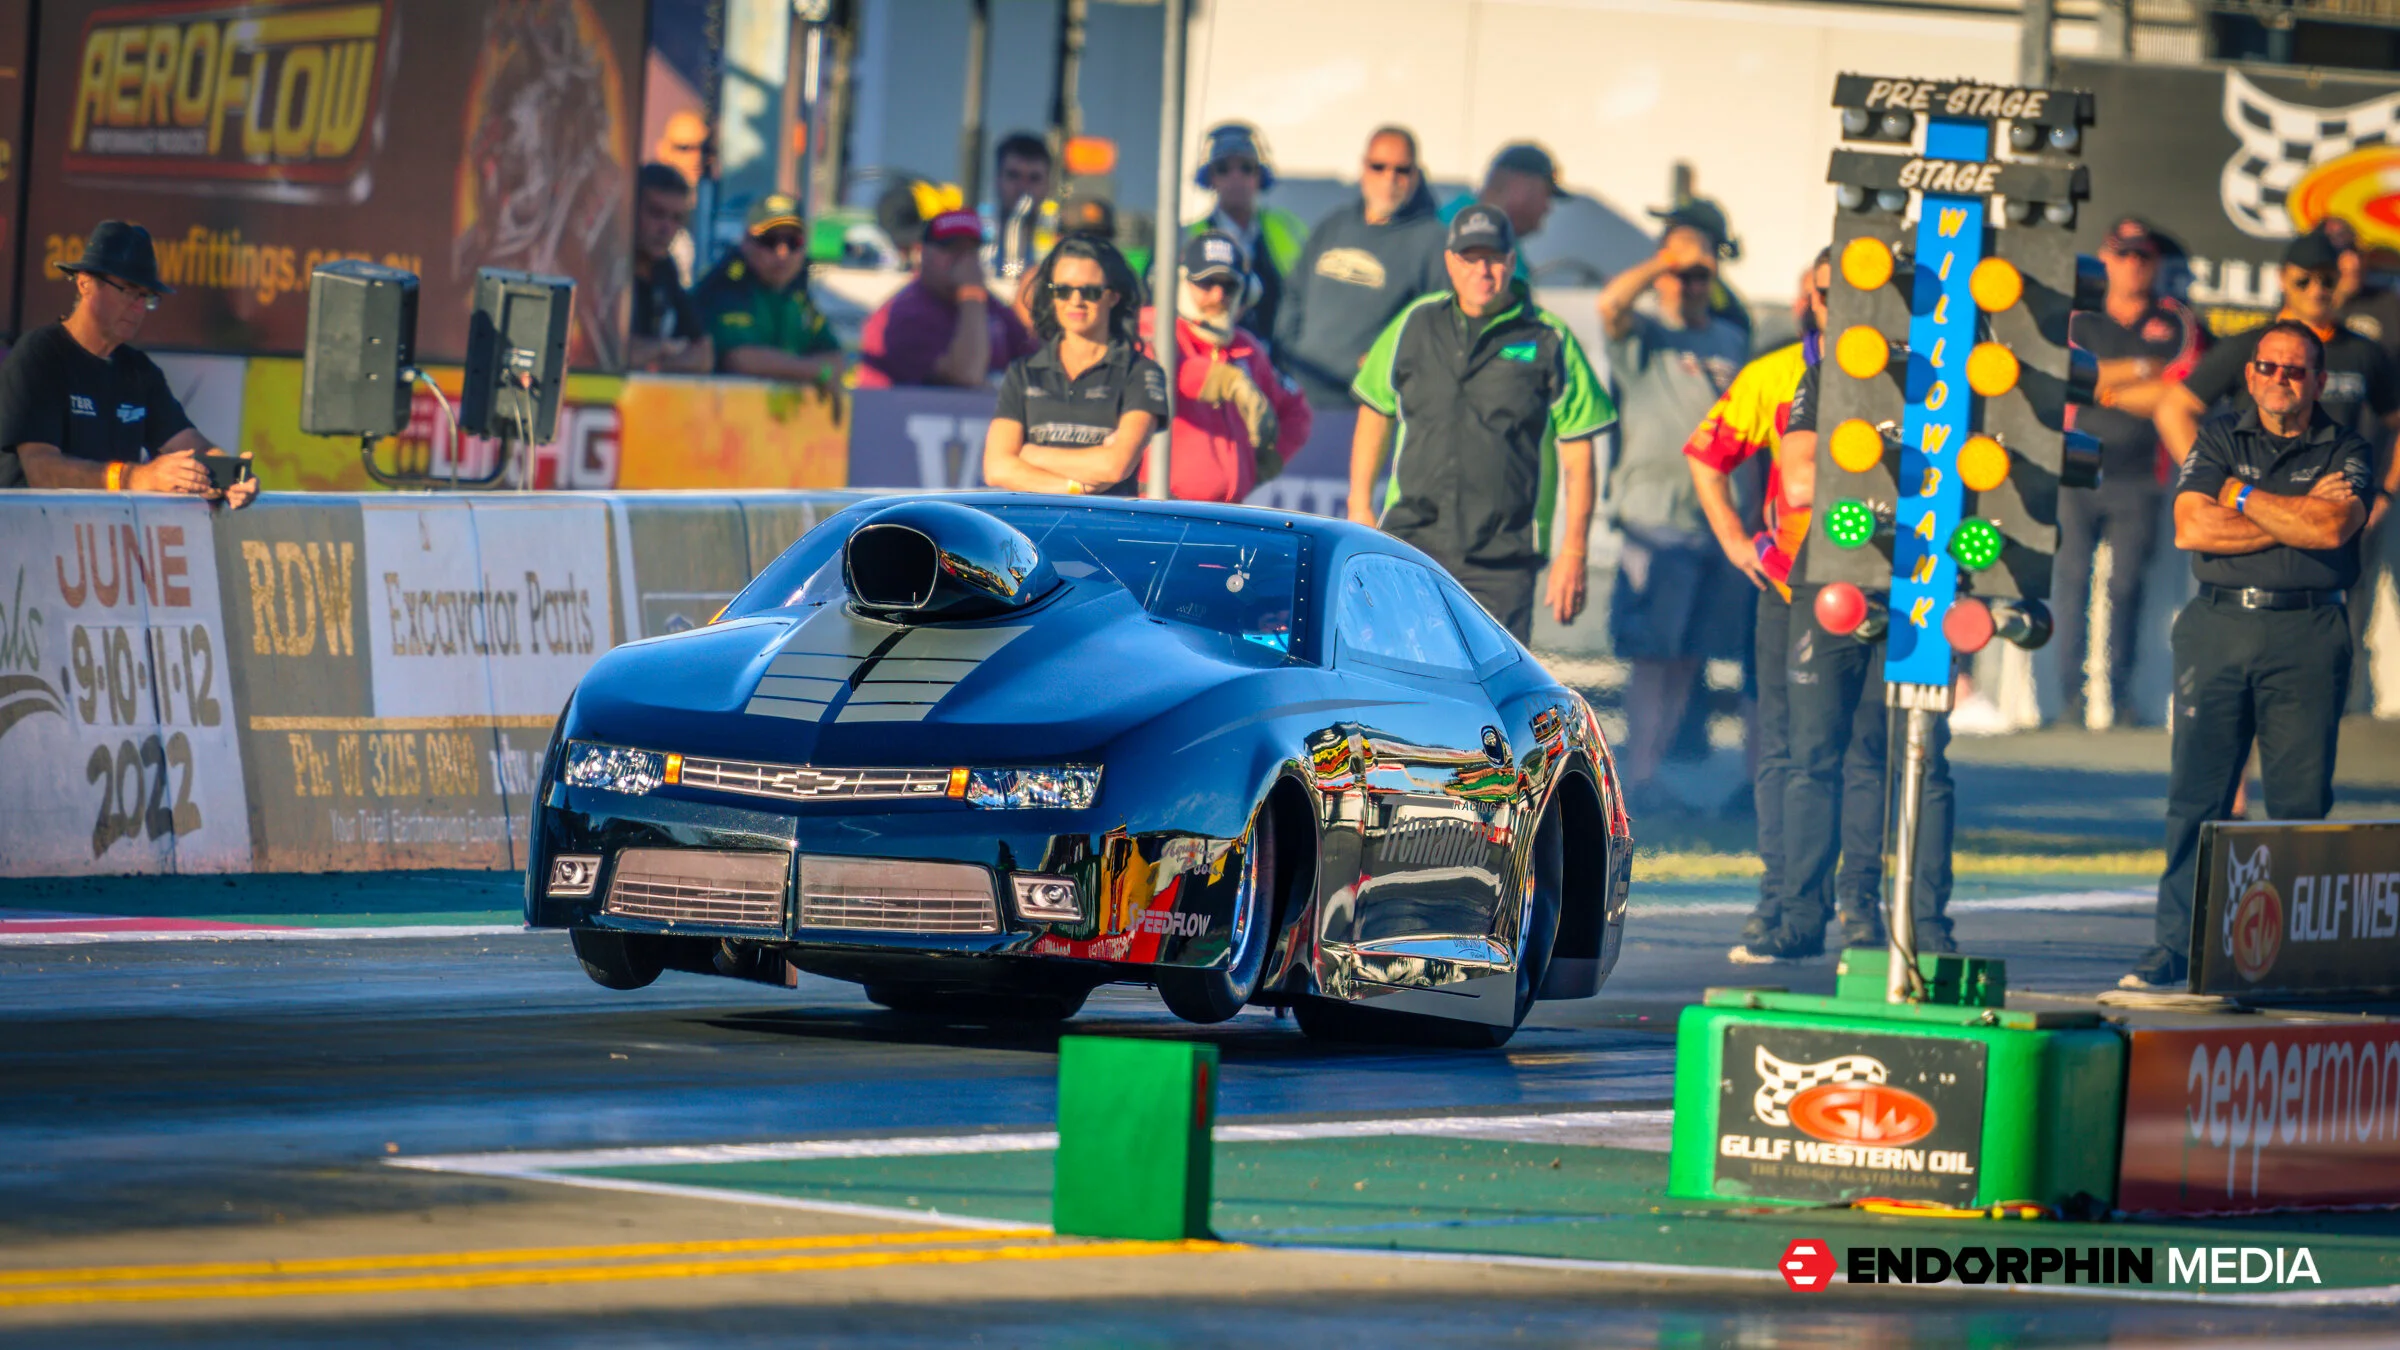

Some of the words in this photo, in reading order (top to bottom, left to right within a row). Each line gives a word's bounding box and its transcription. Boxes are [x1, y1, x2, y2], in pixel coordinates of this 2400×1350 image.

[70, 5, 383, 157] AEROFLOW
[1865, 80, 2049, 119] PRE-STAGE
[1898, 158, 2003, 193] STAGE
[1909, 207, 1967, 629] WILLOWBANK
[55, 522, 192, 609] JUNE
[241, 540, 355, 658] RDW
[383, 571, 523, 657] Excavator
[525, 569, 595, 655] Parts
[86, 730, 203, 861] 2022
[288, 733, 333, 797] Ph:
[1452, 799, 1498, 814] RACING
[1126, 901, 1212, 938] SPEEDFLOW
[2290, 875, 2350, 943] GULF
[1720, 1134, 1792, 1161] GULF
[1794, 1140, 1926, 1173] WESTERN
[1928, 1150, 1975, 1176] OIL
